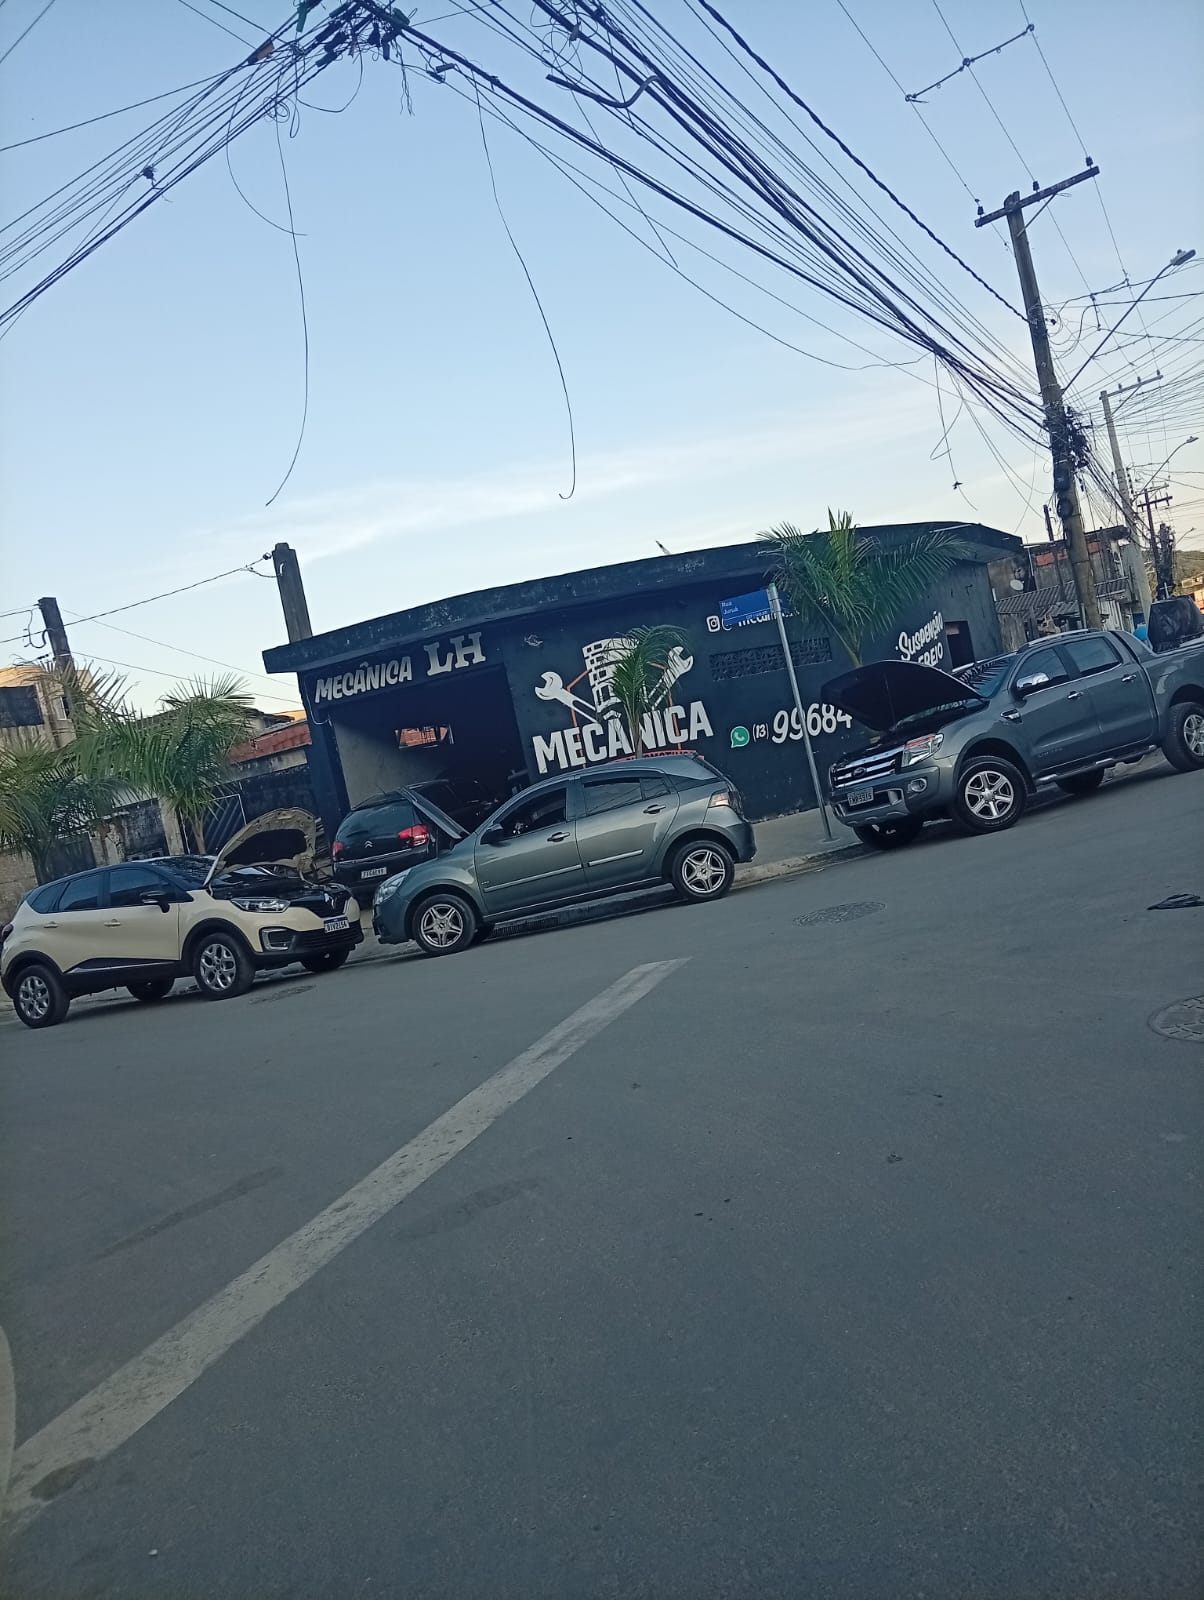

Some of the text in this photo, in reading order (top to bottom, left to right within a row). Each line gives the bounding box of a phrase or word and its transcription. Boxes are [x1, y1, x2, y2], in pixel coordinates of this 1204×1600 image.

[315, 632, 486, 703] MECÂNICA LH
[532, 701, 713, 773] MECÂNICA
[752, 703, 852, 743] (13) 99684
